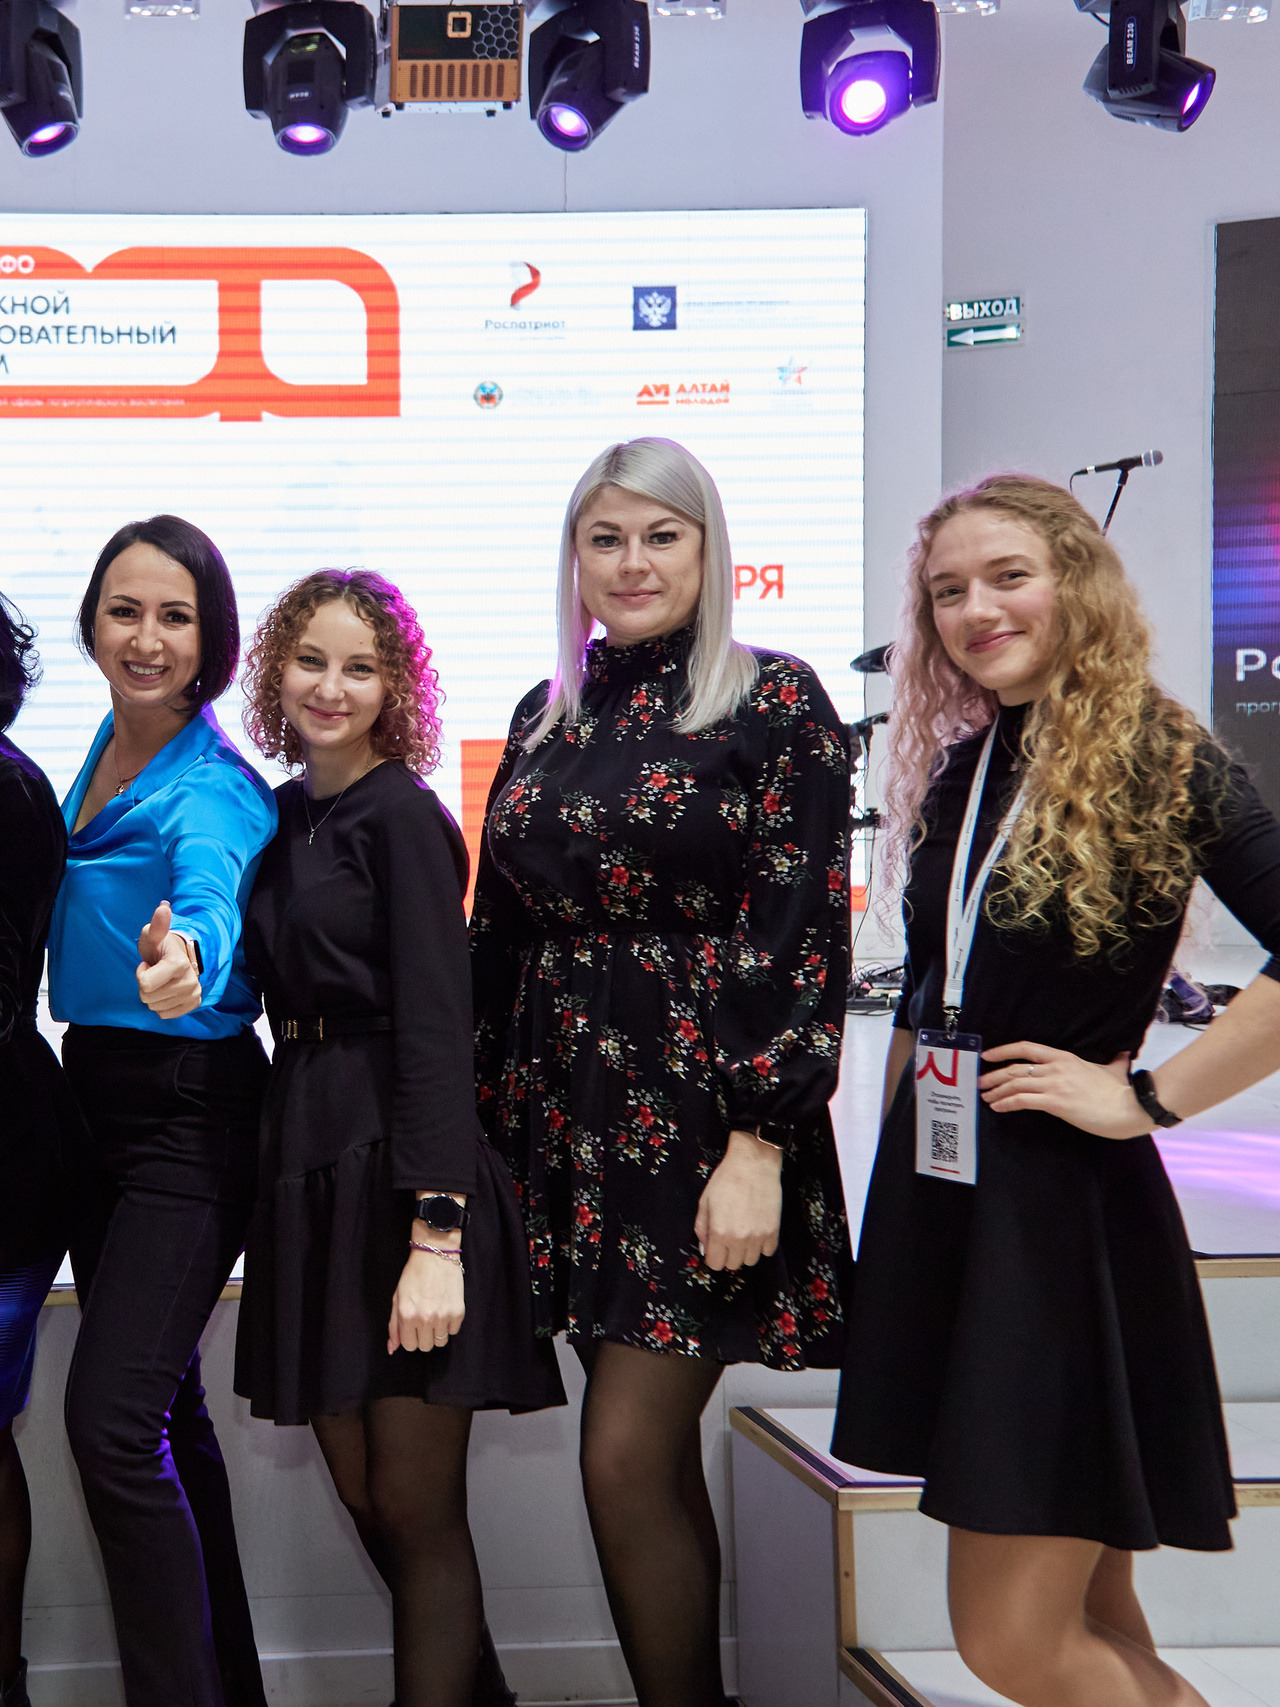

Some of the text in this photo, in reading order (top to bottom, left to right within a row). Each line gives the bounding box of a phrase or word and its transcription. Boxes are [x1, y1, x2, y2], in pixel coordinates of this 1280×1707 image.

[1126, 22, 1135, 65] BEAM 230
[949, 298, 1018, 321] ВЫХОД
[484, 319, 566, 331] Роспатриот
[676, 379, 730, 394] АЛТАЙ
[1235, 648, 1280, 682] Р
[1236, 701, 1280, 716] прог
